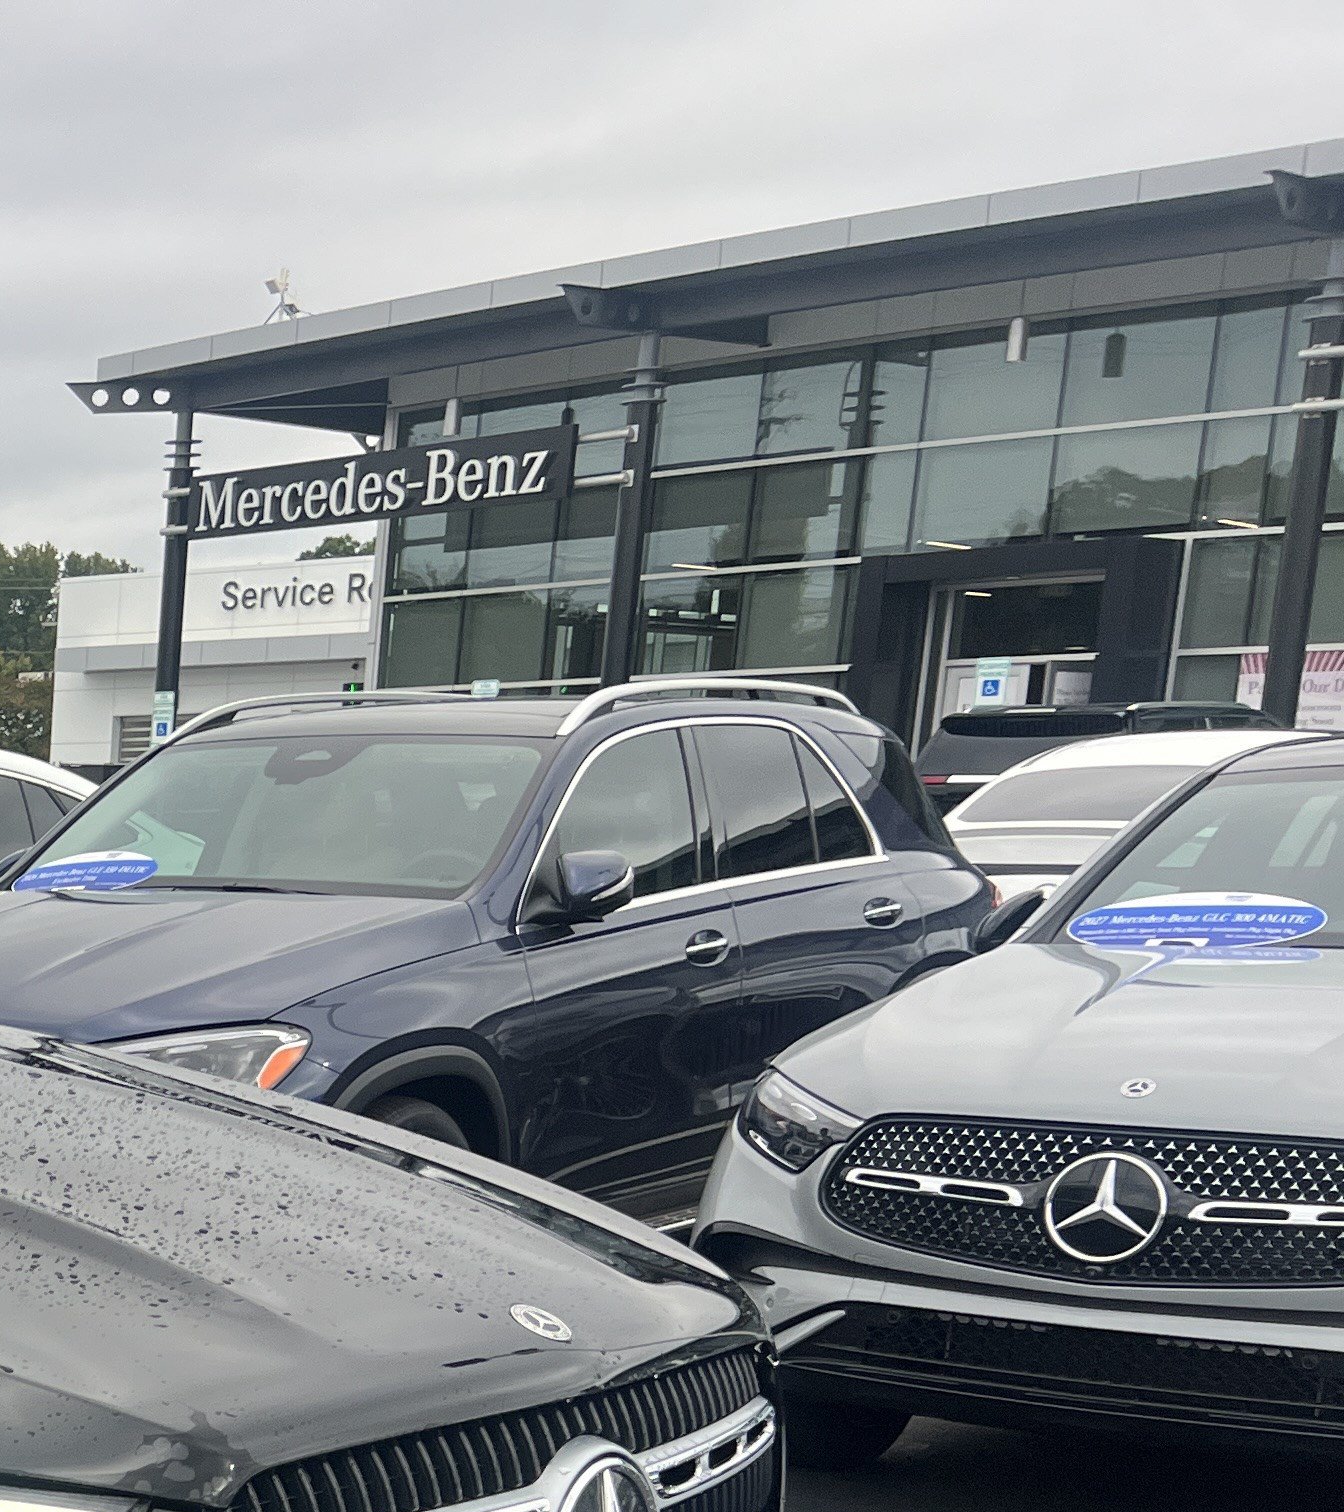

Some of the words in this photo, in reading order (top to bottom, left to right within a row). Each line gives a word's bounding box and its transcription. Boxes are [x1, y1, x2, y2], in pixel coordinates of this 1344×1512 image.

[194, 448, 549, 533] Mercedes-Benz
[221, 576, 335, 611] Service
[1201, 912, 1231, 923] GLC
[1231, 913, 1257, 923] 300
[1257, 914, 1312, 926] 4MATIC
